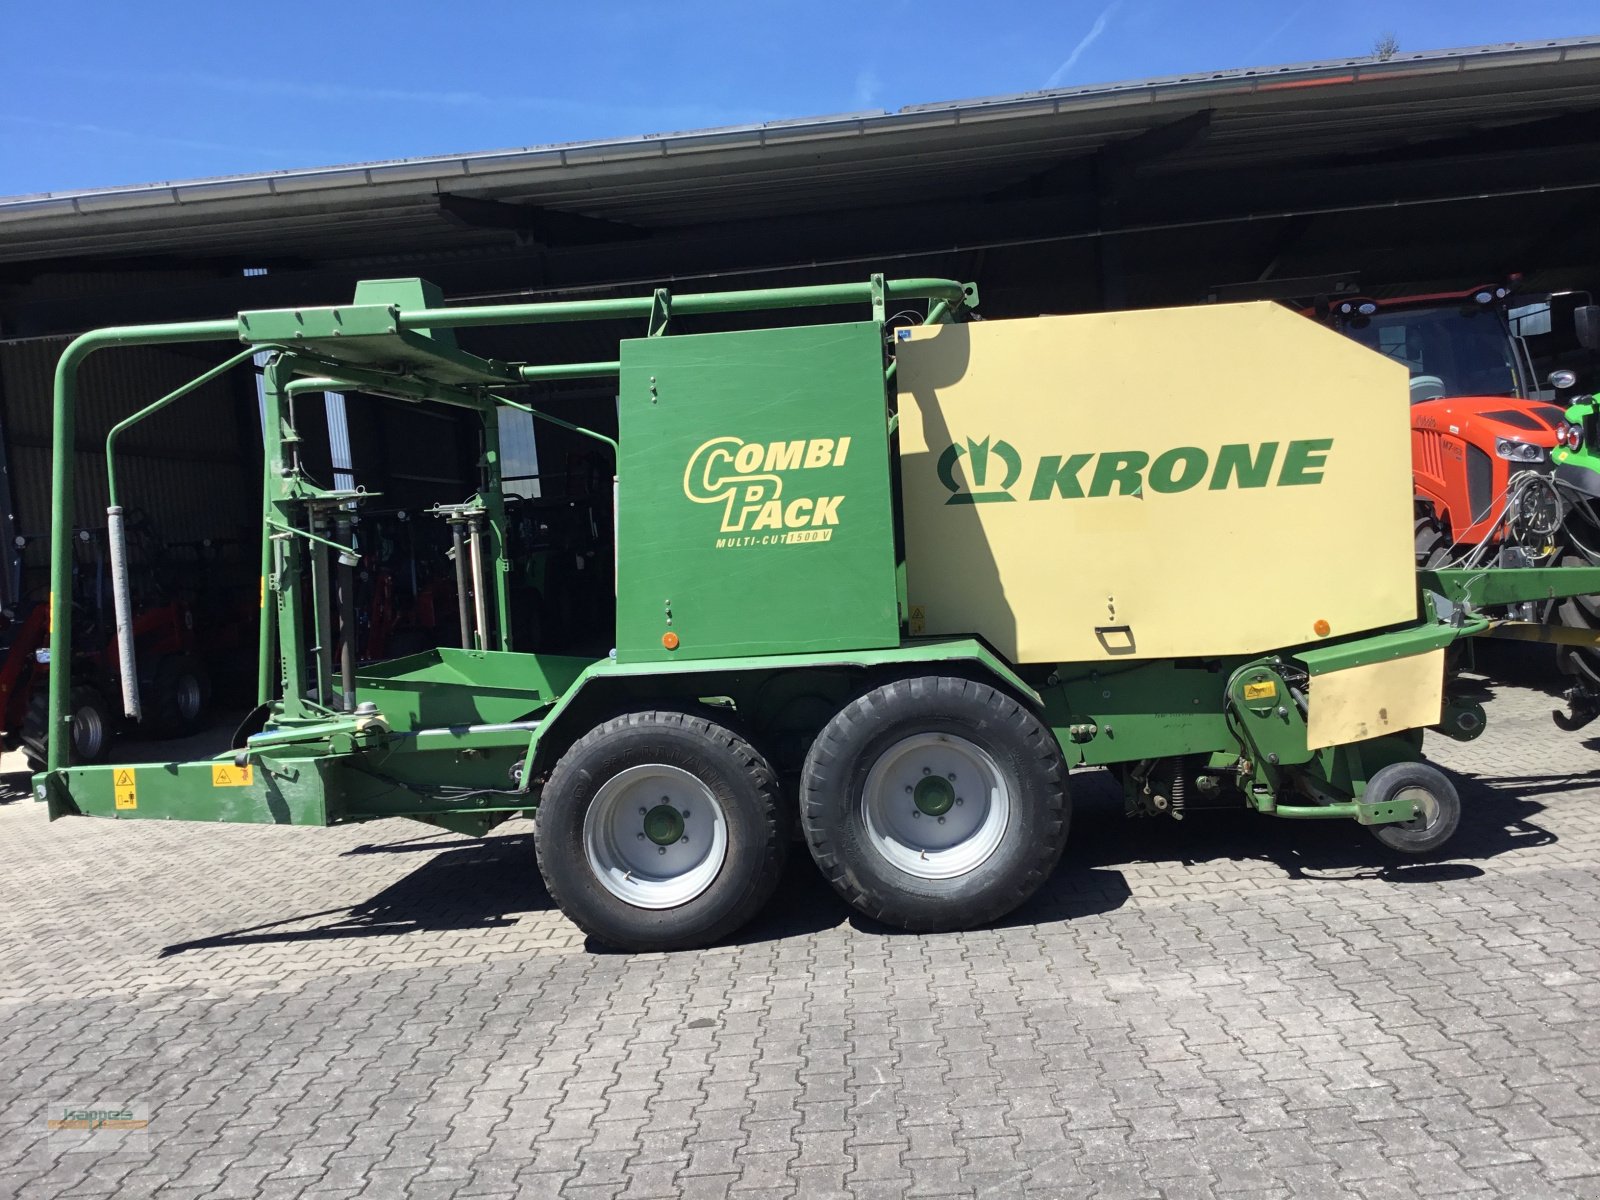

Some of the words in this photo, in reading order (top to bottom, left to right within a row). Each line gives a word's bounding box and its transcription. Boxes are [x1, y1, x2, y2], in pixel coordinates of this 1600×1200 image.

[684, 436, 851, 503] COMBI
[1028, 438, 1334, 500] KRONE
[720, 474, 845, 532] PACK
[716, 534, 787, 549] MULTI-CUT
[788, 531, 819, 542] 1500
